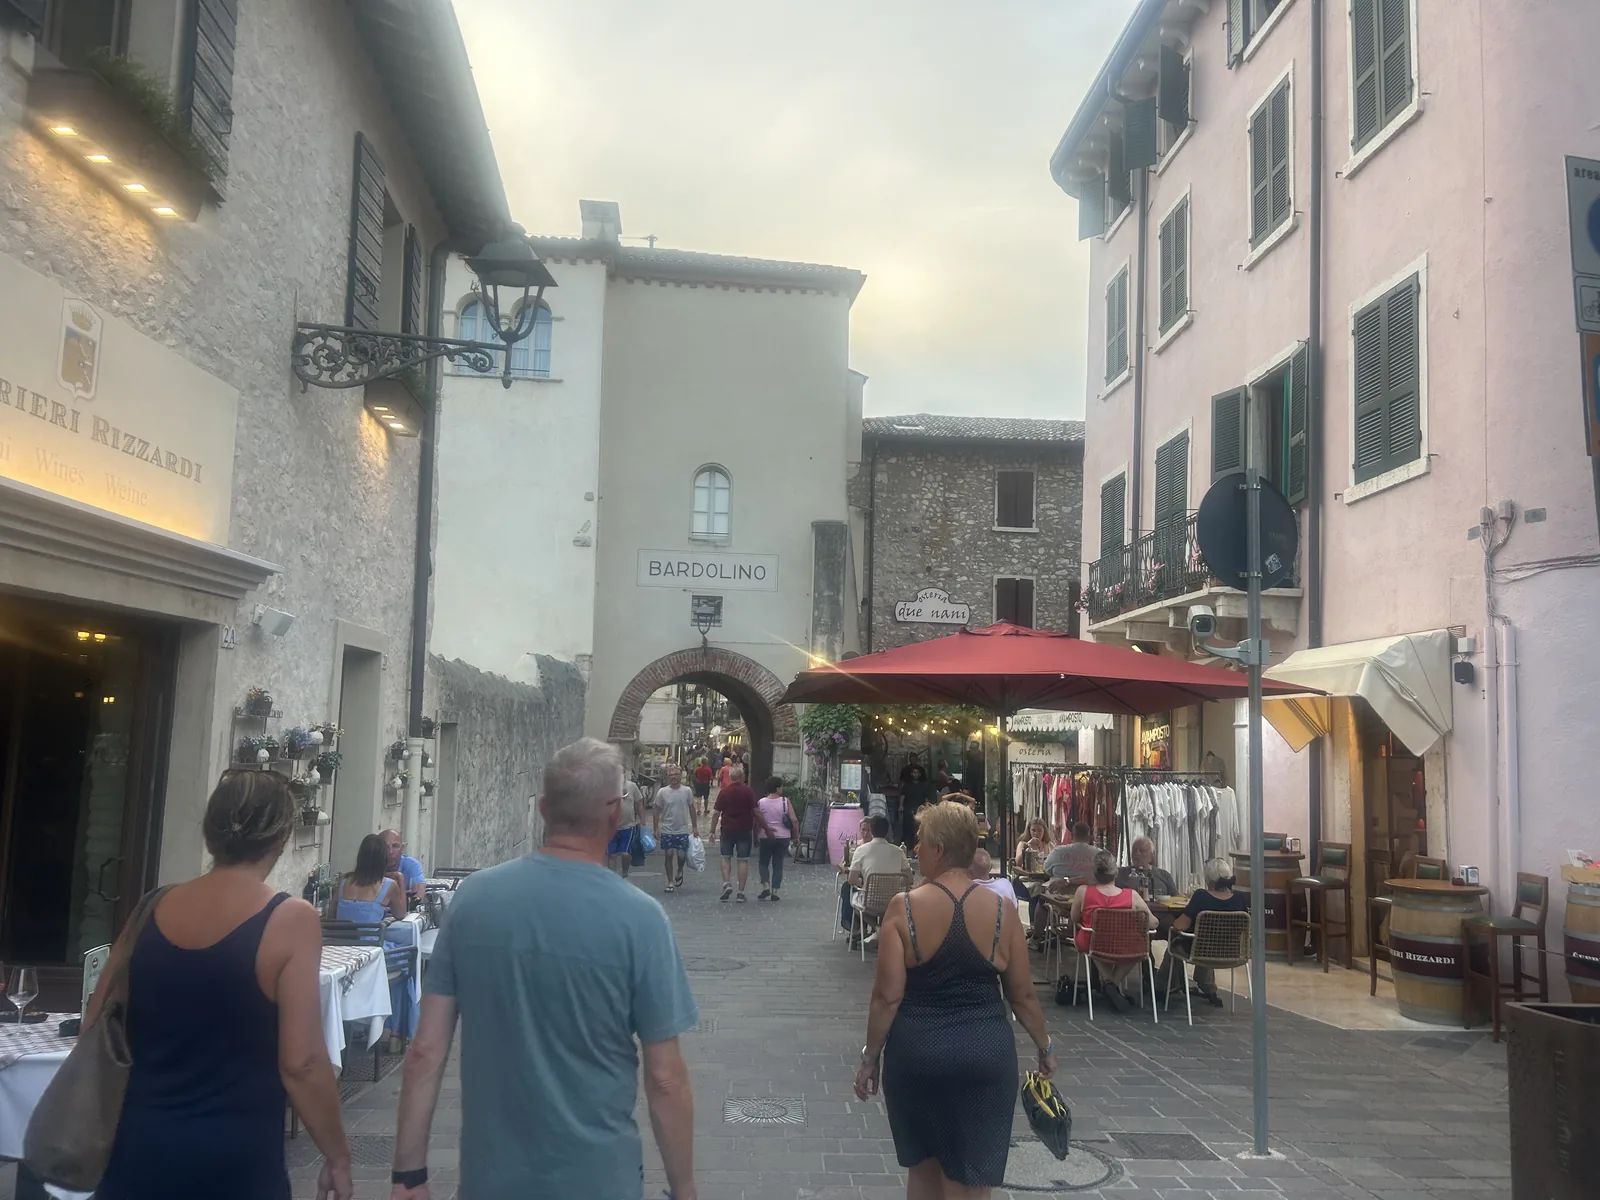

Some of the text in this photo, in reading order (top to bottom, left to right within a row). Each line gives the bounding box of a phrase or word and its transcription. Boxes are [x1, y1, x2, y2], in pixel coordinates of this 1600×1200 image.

[1574, 168, 1600, 180] area
[91, 414, 203, 483] RIZZARDI
[36, 446, 86, 485] Wines
[104, 472, 148, 507] Weine
[649, 560, 766, 581] BARDOLINO
[918, 591, 948, 604] osteria
[898, 603, 967, 621] due nani
[223, 627, 235, 645] 2A
[1019, 748, 1052, 756] osteria
[1405, 951, 1455, 964] RIZZARDI
